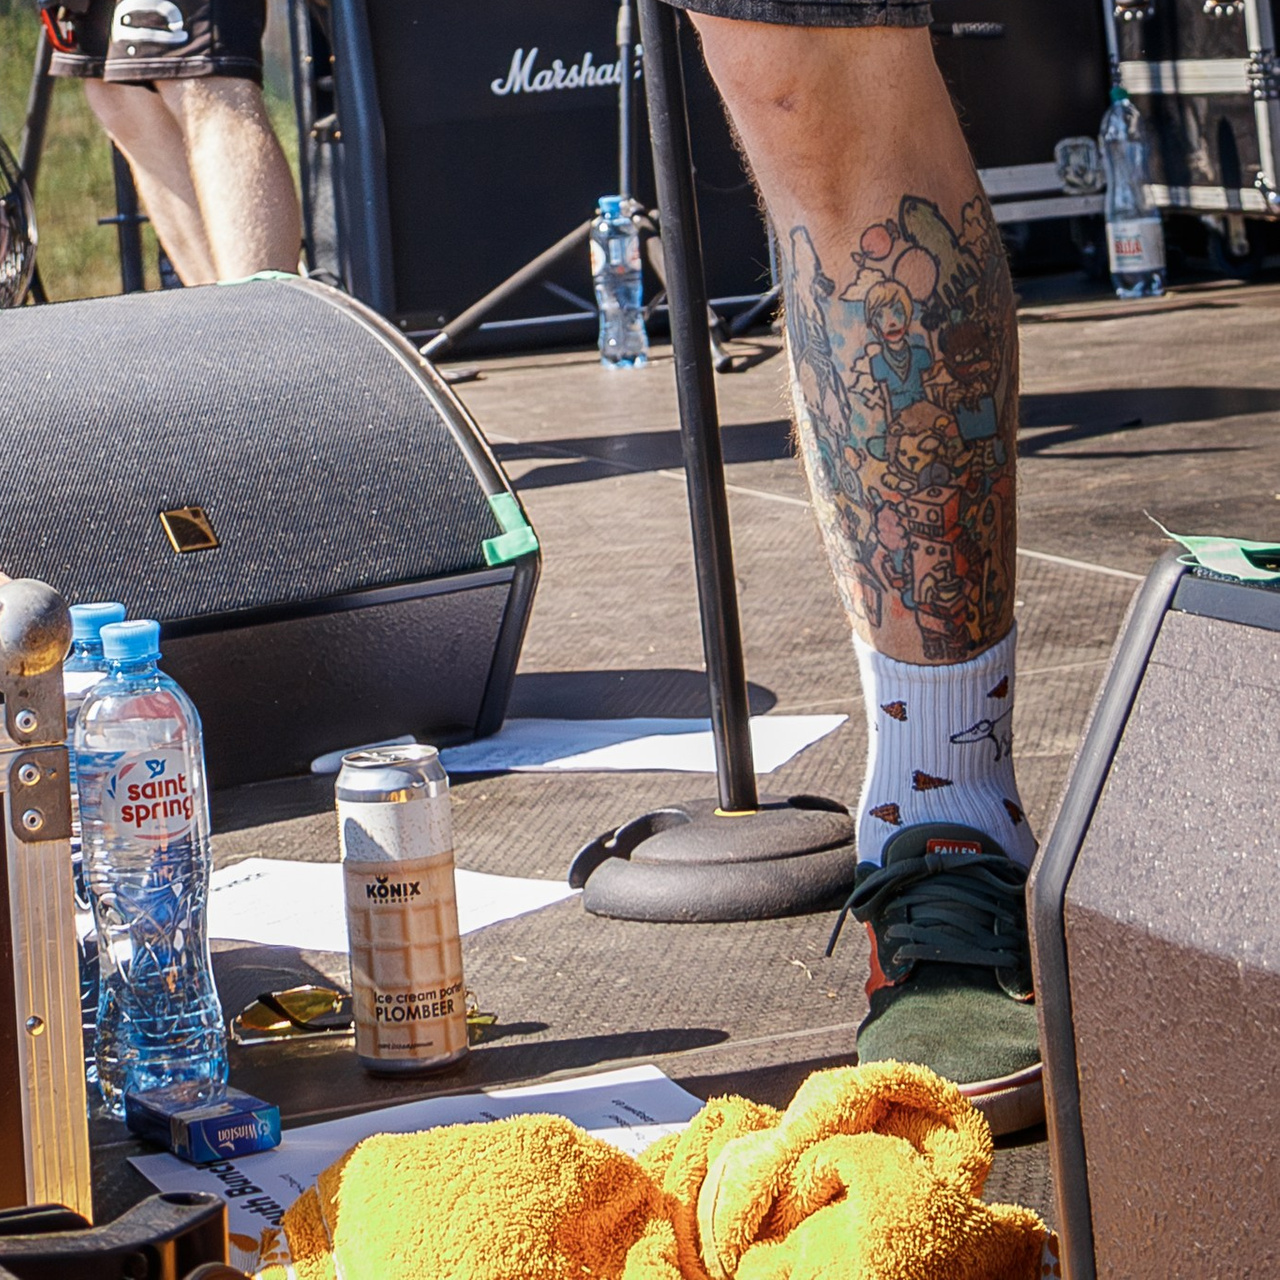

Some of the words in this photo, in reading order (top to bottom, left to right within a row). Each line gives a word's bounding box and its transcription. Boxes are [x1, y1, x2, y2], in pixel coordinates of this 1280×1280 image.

[127, 773, 187, 802] saint
[121, 794, 194, 828] spring
[373, 991, 393, 1005] Ice
[396, 989, 437, 1005] cream
[375, 999, 455, 1023] PLOMBEER
[218, 1123, 258, 1143] Winston
